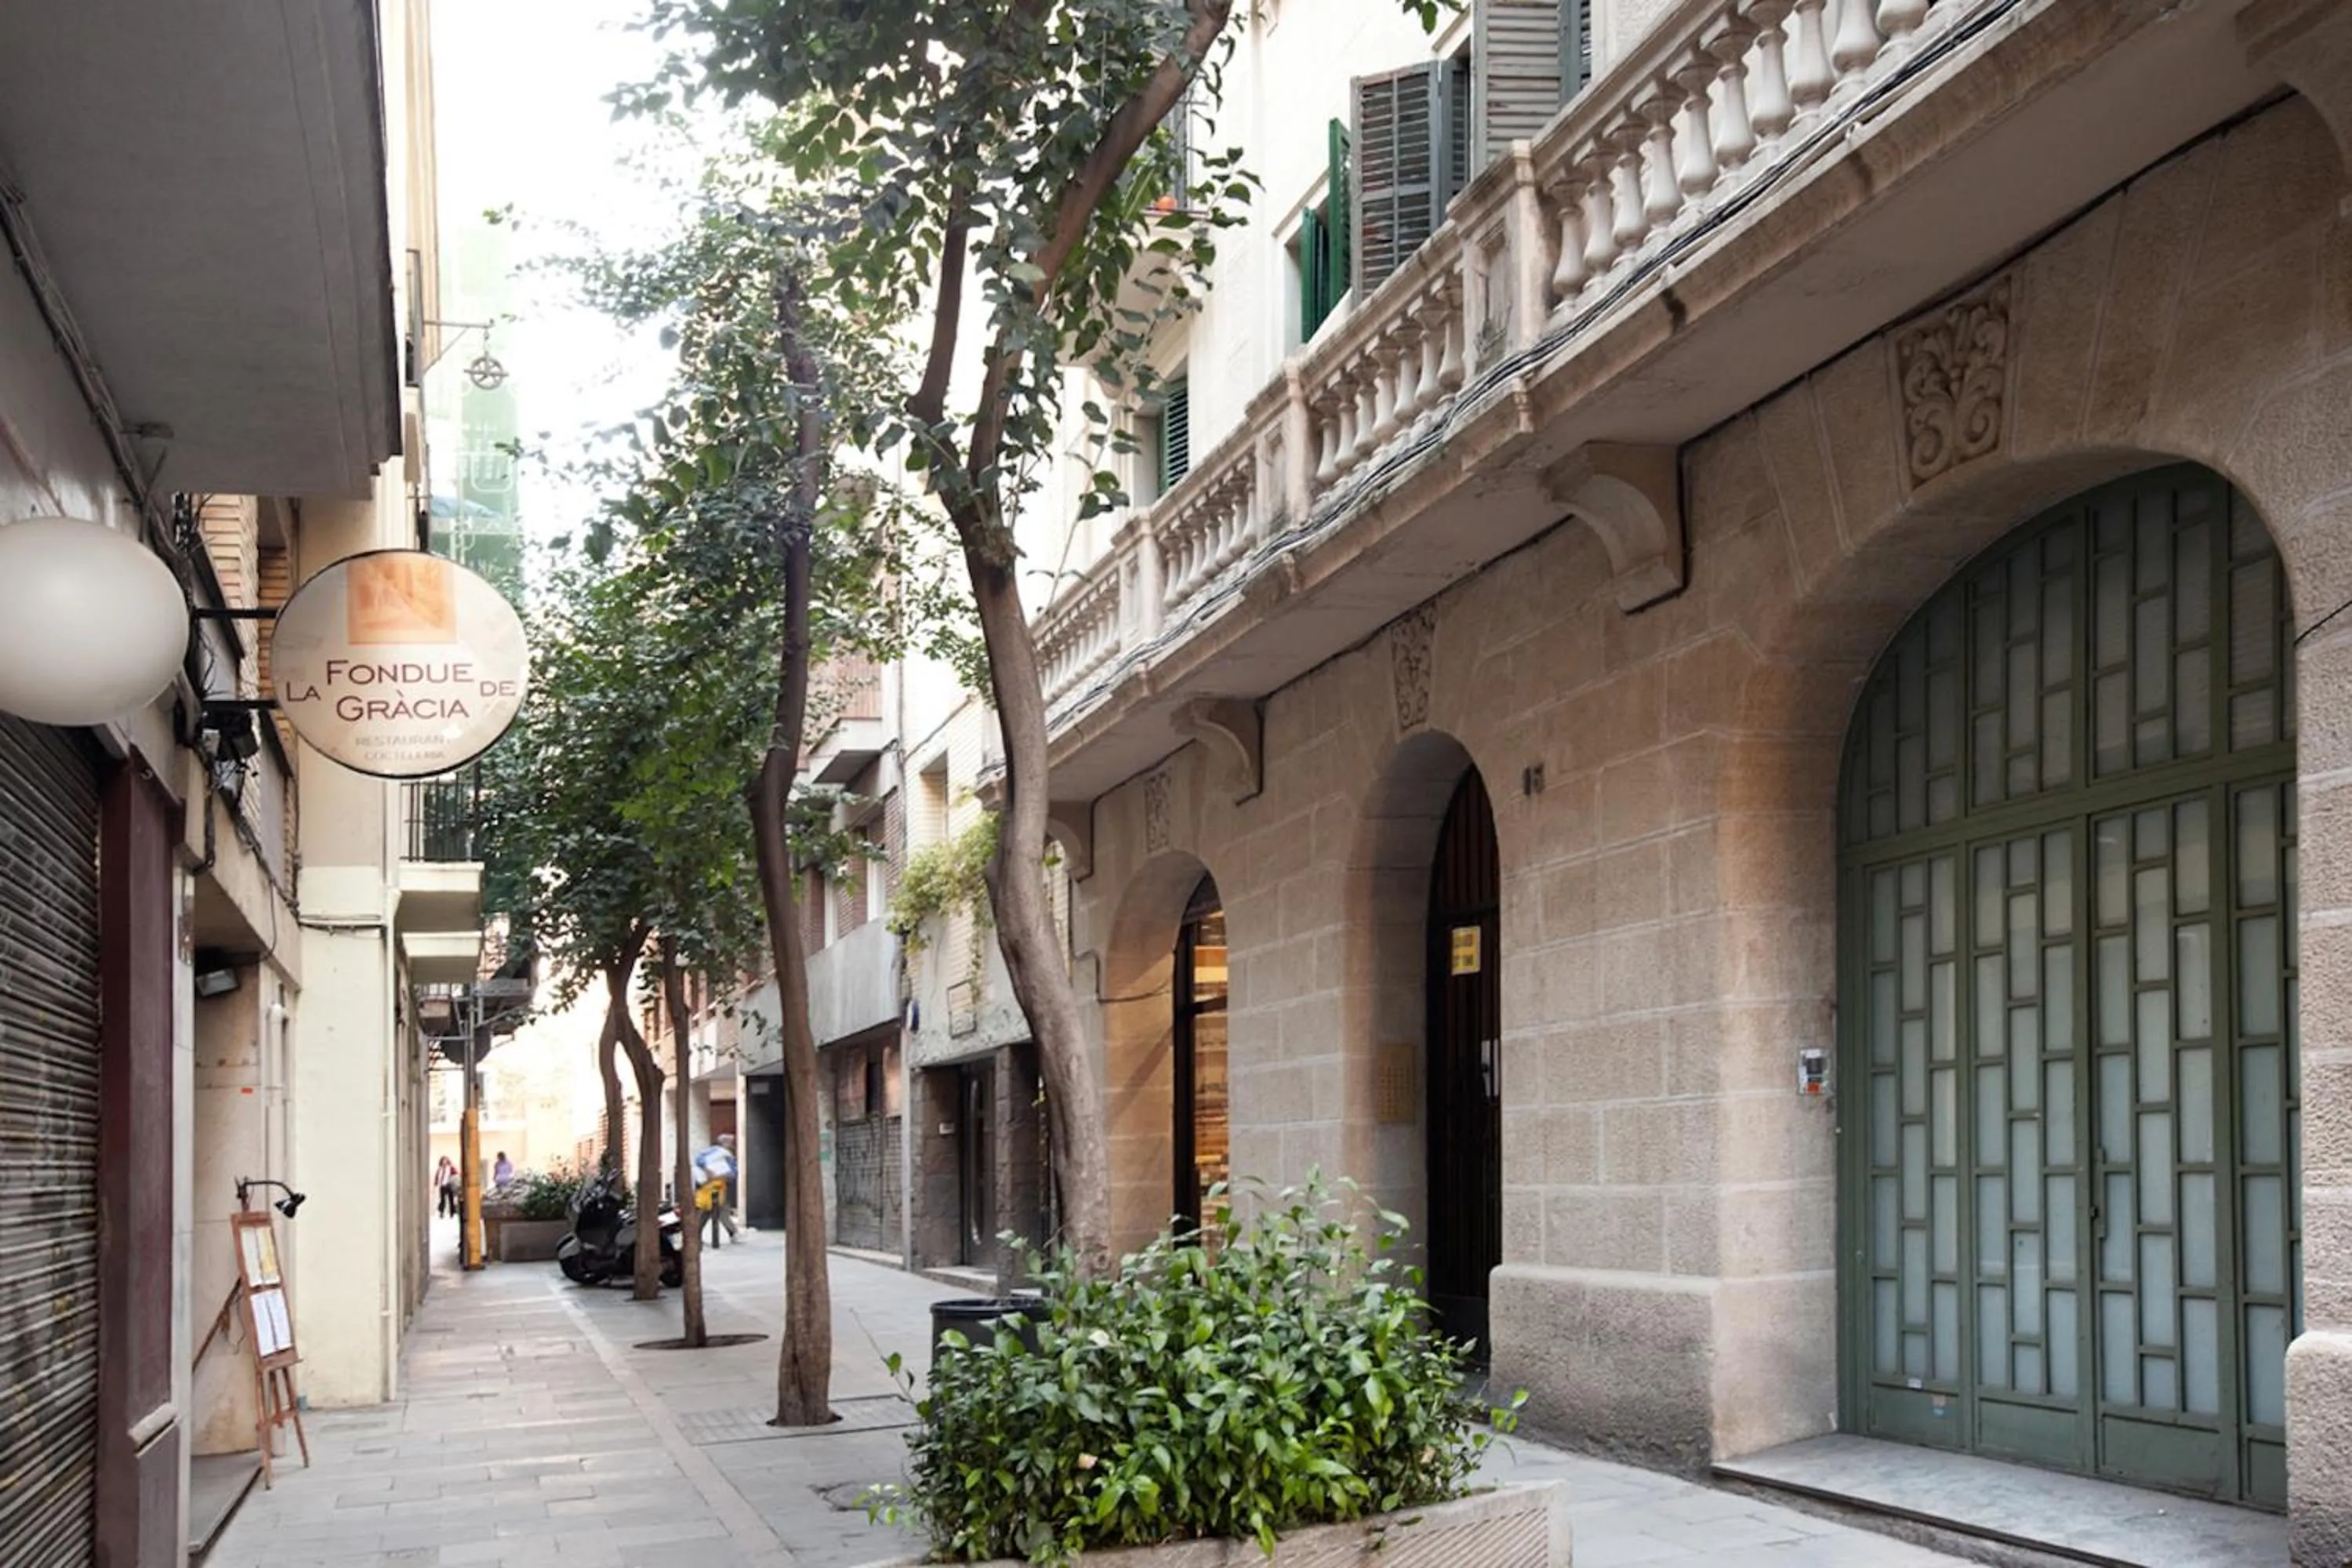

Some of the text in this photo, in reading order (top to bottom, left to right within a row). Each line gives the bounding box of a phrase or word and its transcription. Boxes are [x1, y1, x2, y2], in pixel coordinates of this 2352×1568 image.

[326, 660, 474, 684] FONDUE
[287, 682, 321, 702] LA
[479, 681, 516, 696] DE
[336, 690, 470, 720] GRÀCIA
